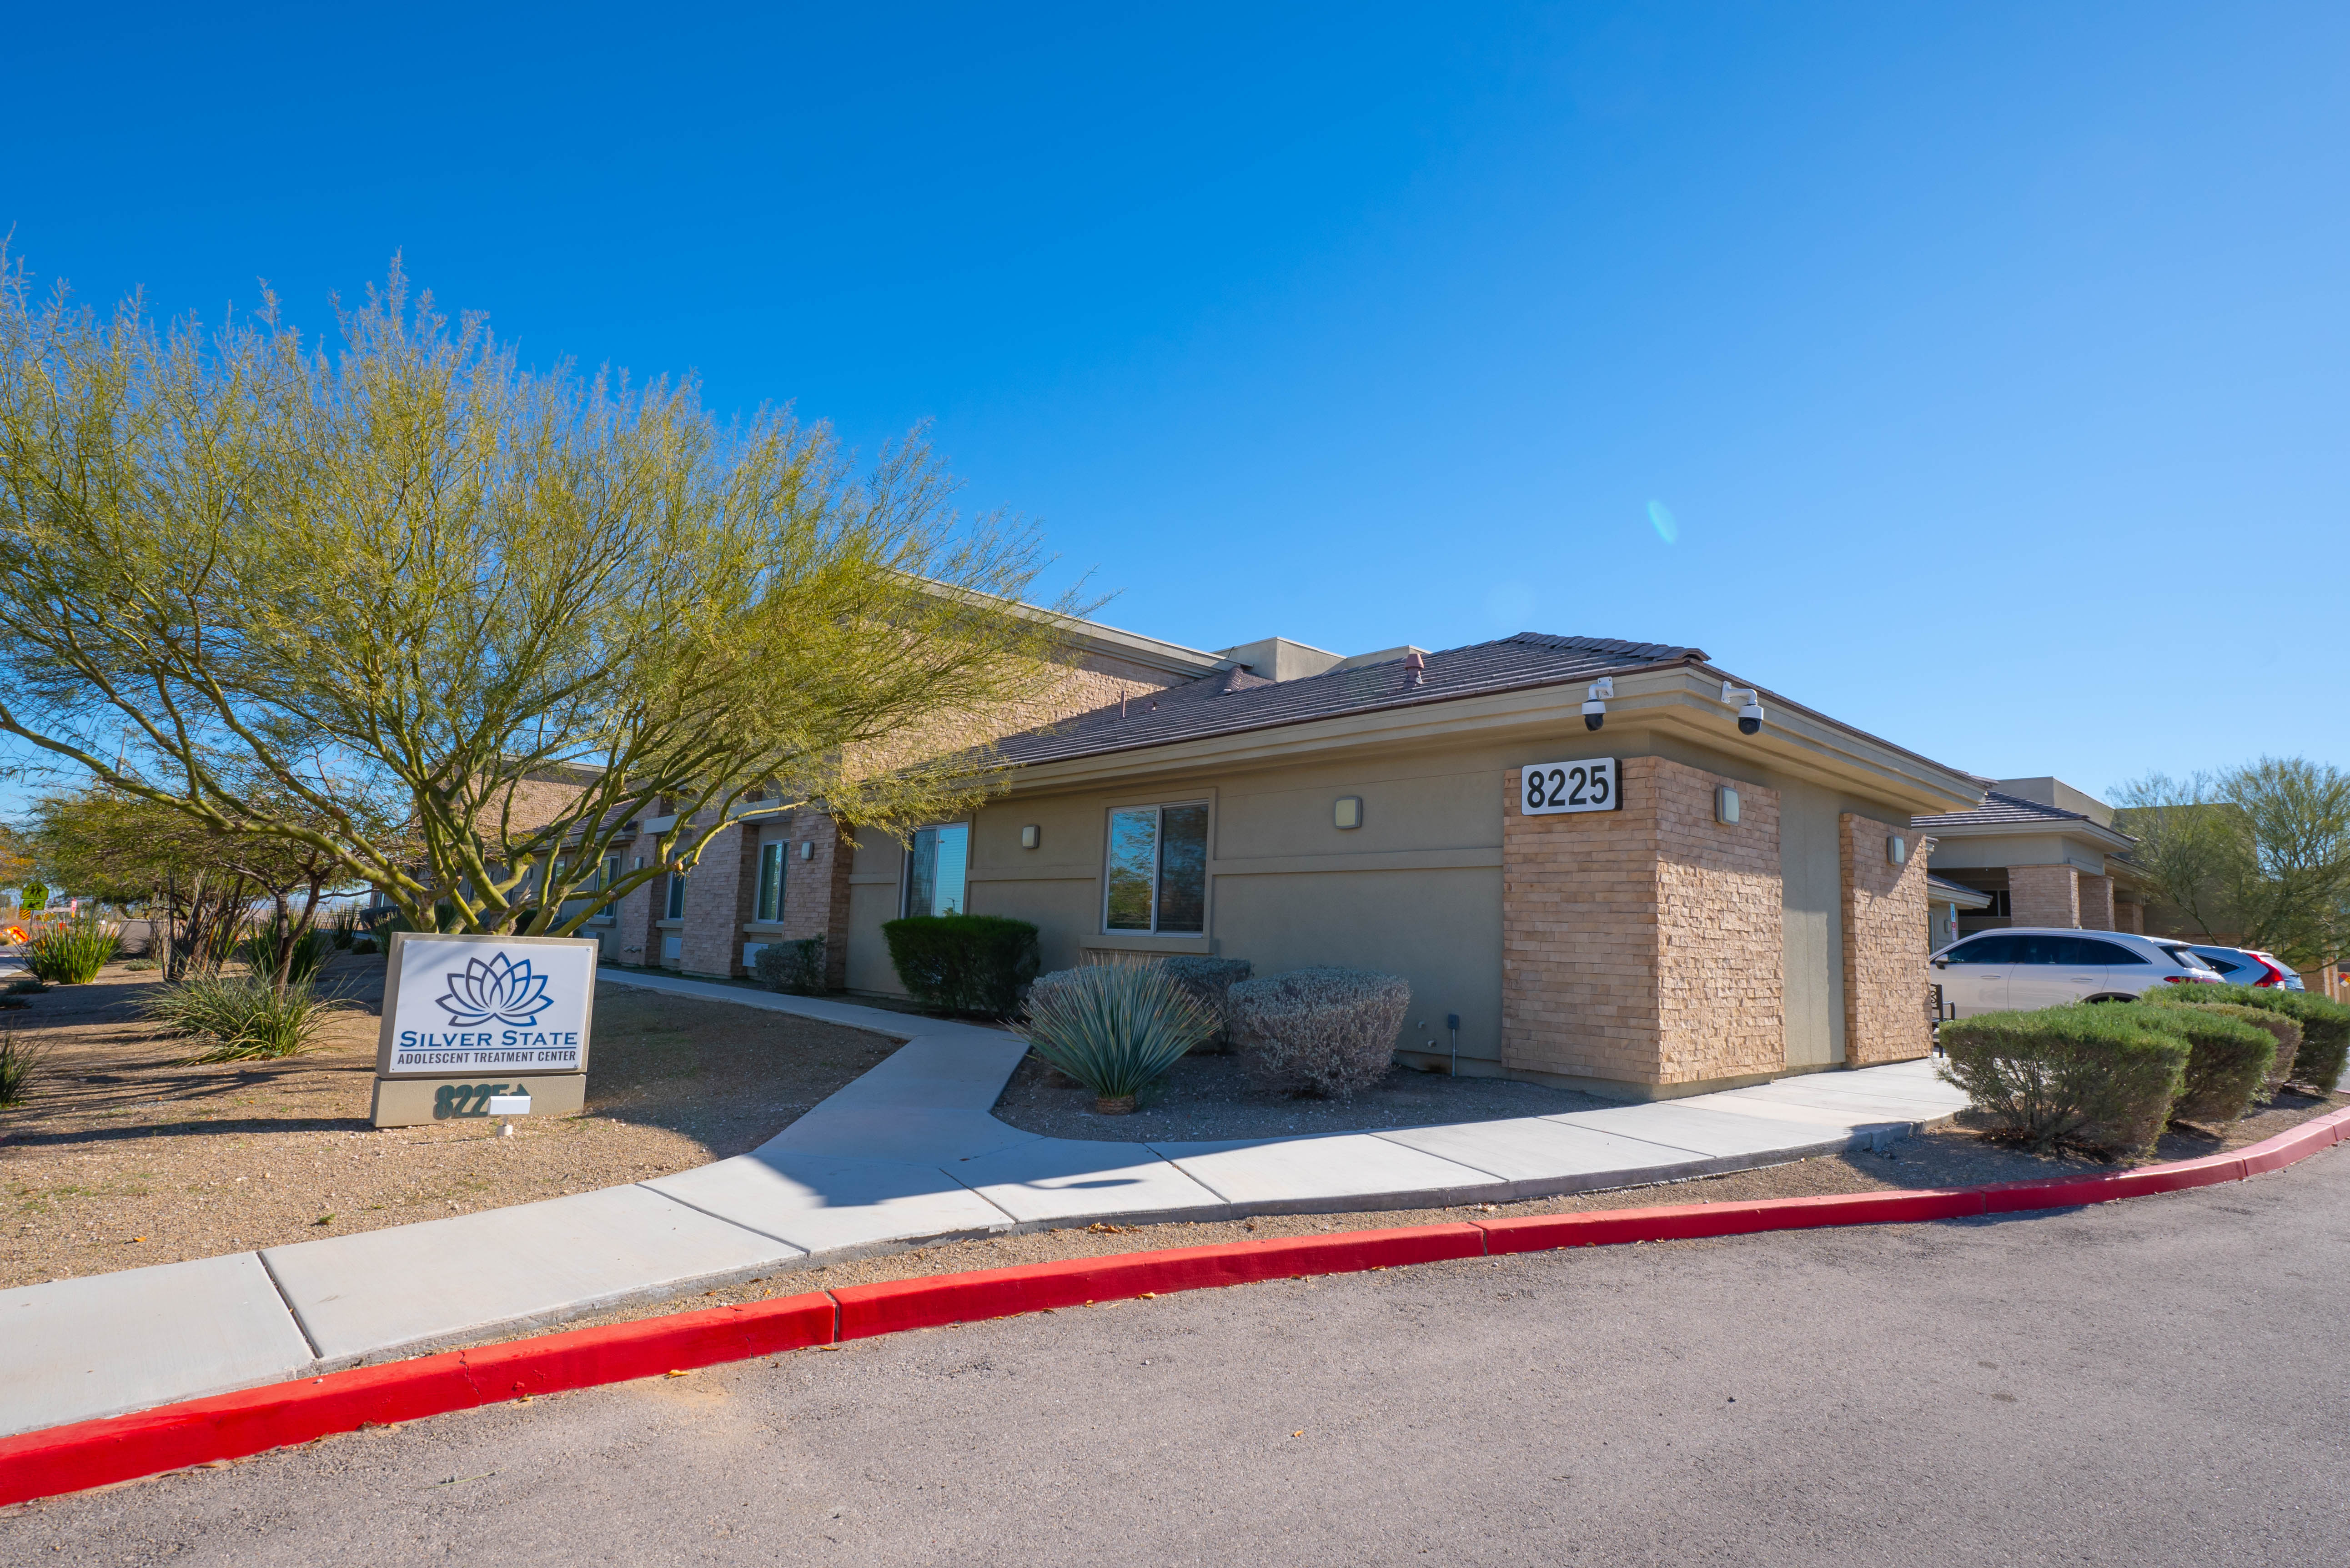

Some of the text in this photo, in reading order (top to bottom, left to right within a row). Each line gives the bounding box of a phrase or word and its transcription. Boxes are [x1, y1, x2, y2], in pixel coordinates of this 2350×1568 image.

[1527, 764, 1609, 808] 8225
[400, 1030, 578, 1047] SILVER STATE
[397, 1050, 576, 1064] ADOLESCENT TREATMENT CENTER
